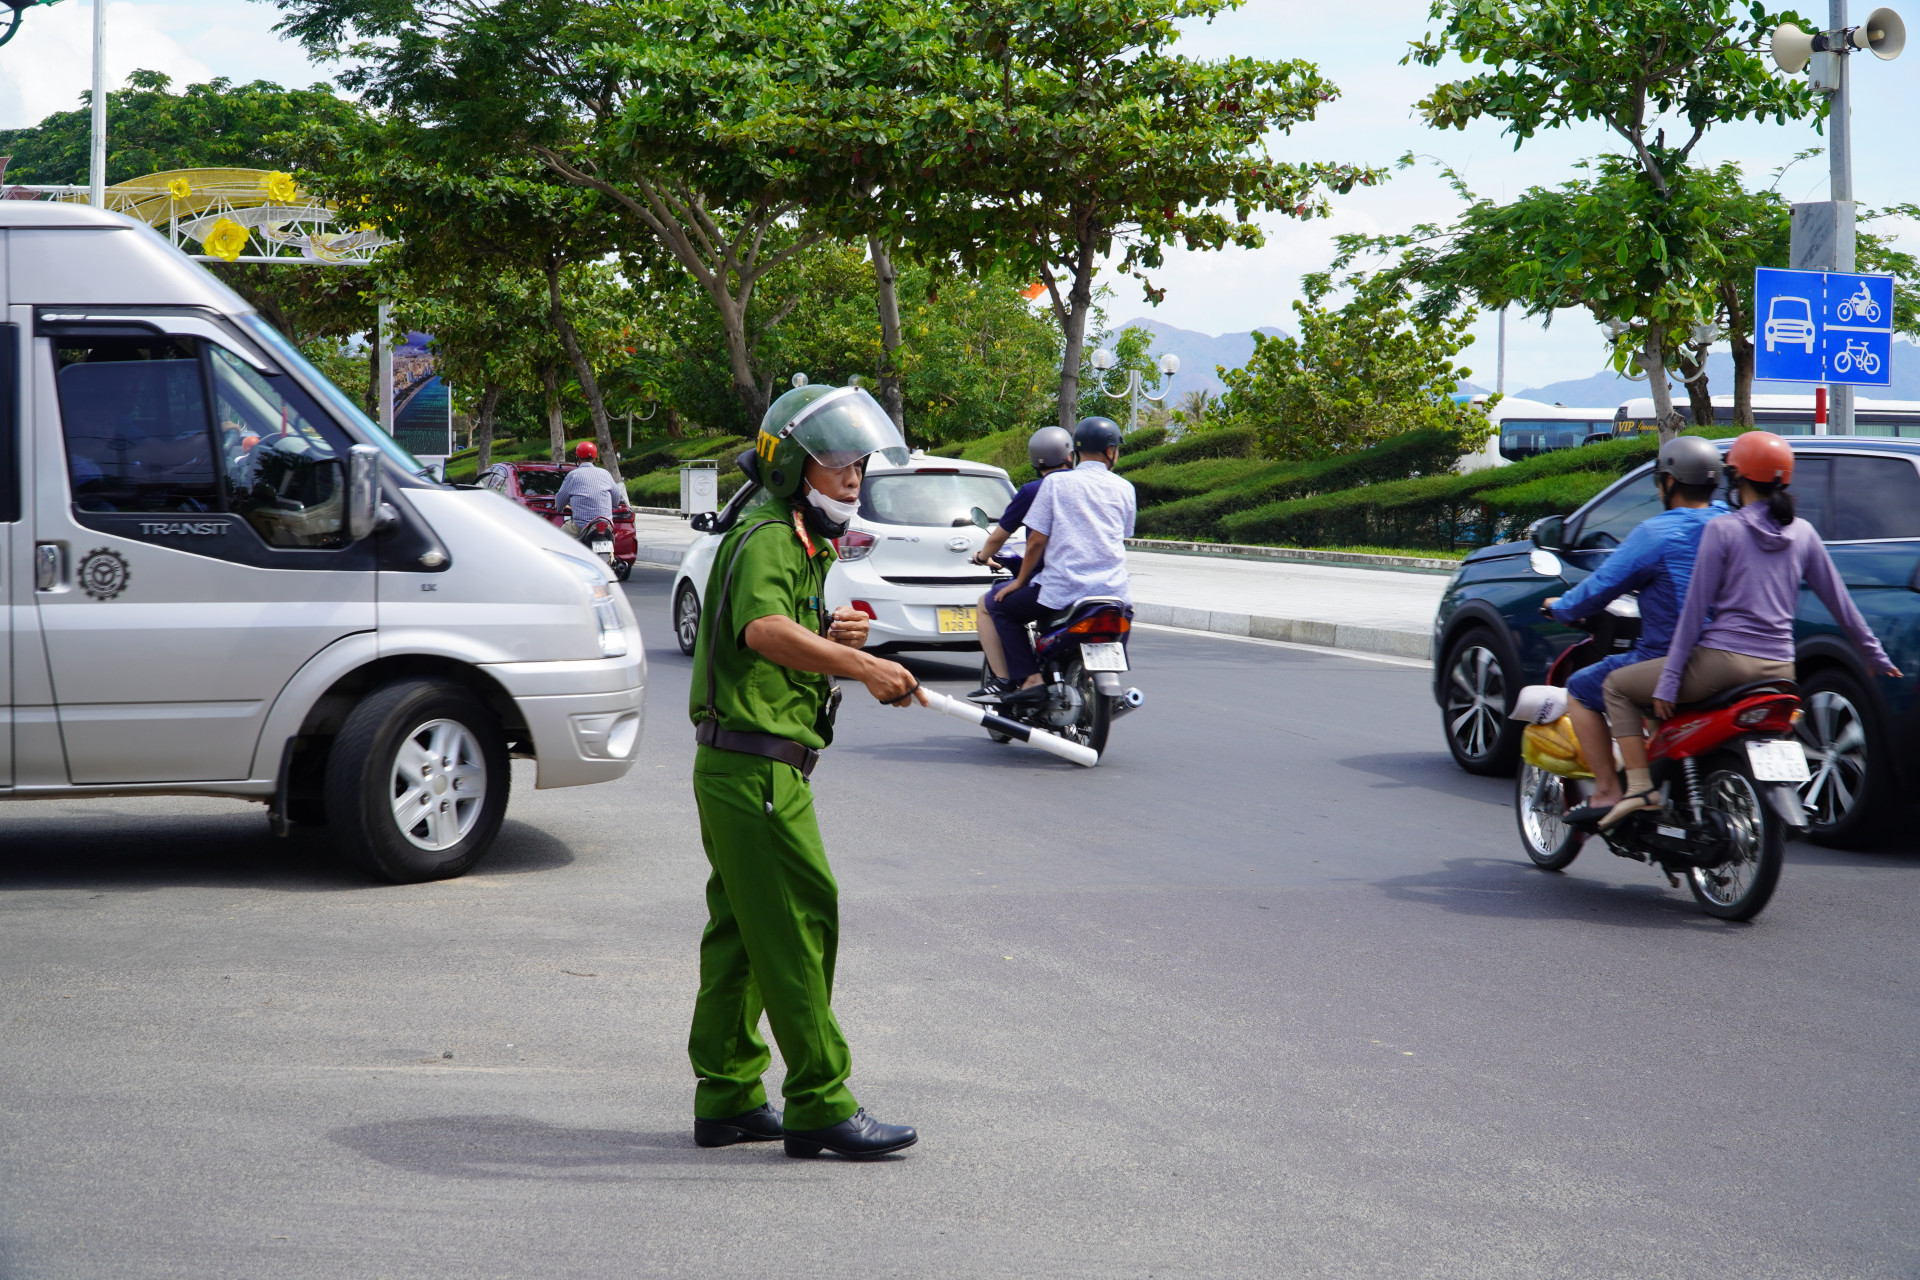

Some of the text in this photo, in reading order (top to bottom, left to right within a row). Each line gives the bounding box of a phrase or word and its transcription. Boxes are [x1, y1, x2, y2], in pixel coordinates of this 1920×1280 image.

[1618, 421, 1635, 432] VIP
[139, 522, 232, 535] TRANSIT
[951, 608, 971, 620] 79A
[945, 621, 977, 631] 128.3
